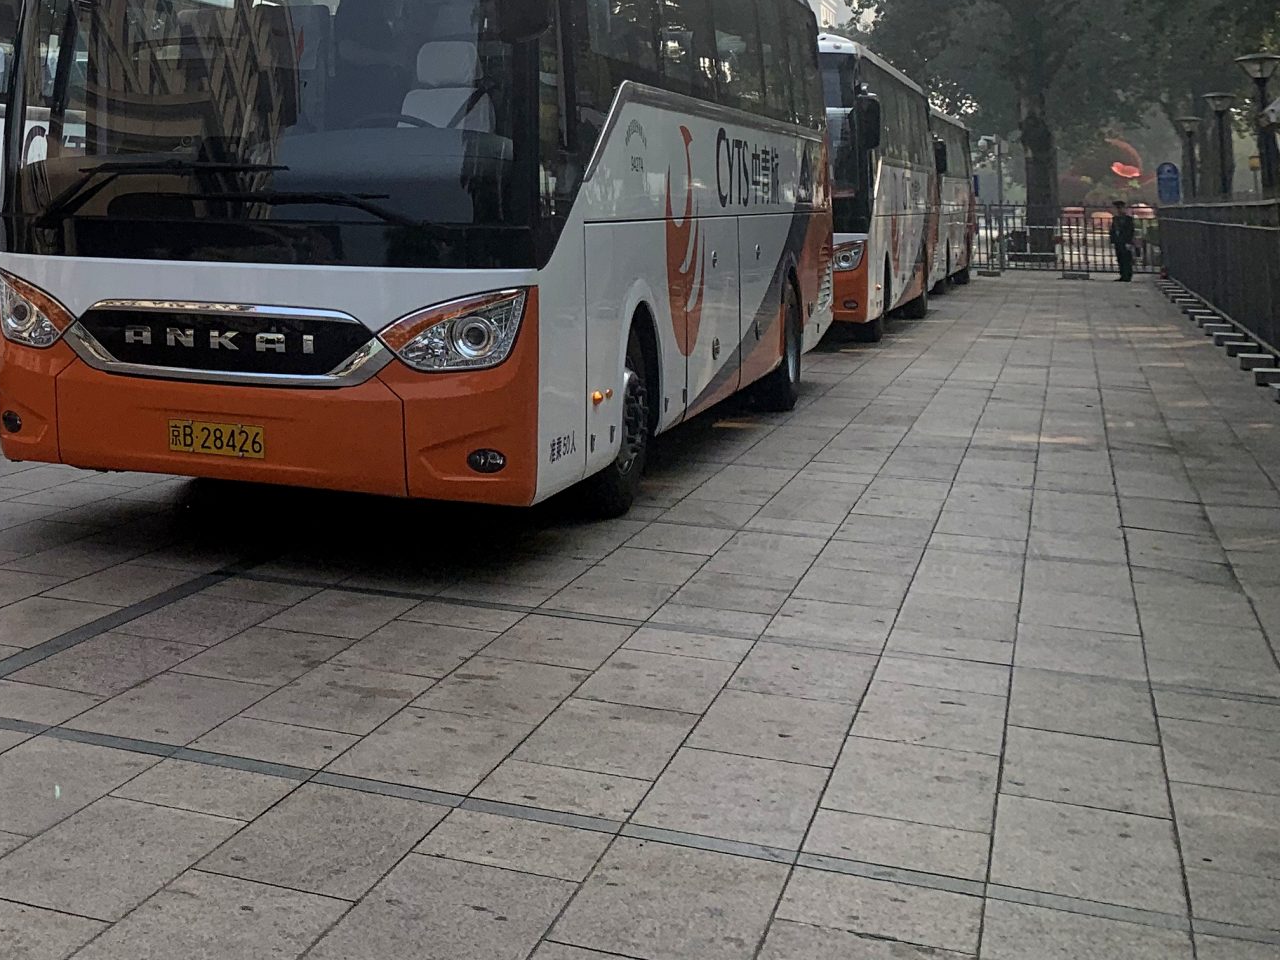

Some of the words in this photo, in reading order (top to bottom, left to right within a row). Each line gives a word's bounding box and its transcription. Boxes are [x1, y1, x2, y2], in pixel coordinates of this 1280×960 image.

[716, 127, 750, 207] CYTS
[751, 143, 780, 205] 中青旅
[125, 325, 315, 354] ANKAI
